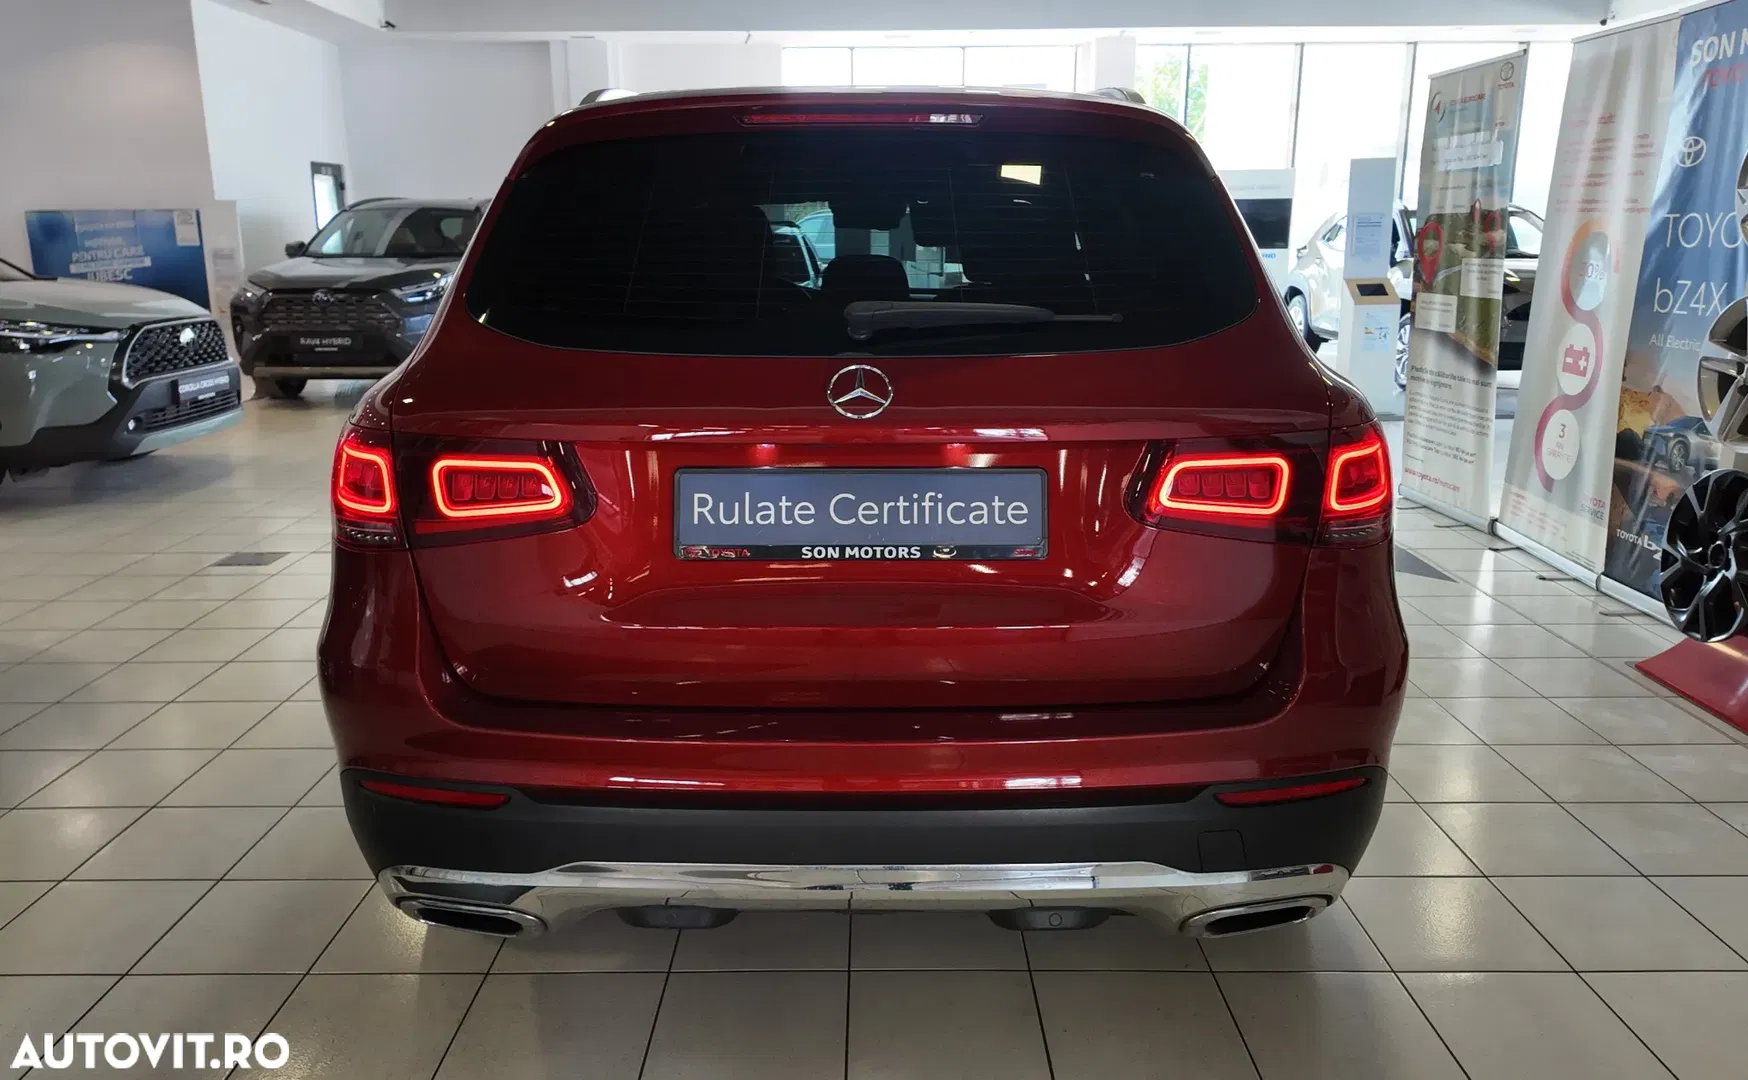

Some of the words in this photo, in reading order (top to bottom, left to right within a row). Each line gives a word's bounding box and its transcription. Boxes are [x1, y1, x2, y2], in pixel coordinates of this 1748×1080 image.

[1690, 31, 1736, 68] SON
[1653, 277, 1728, 316] bZ4X
[1649, 333, 1664, 347] All
[1665, 335, 1702, 352] Electric
[1559, 423, 1567, 439] 3
[692, 492, 816, 525] Rulate
[828, 492, 1029, 525] Certificate
[1616, 528, 1643, 546] TOYOTA
[801, 546, 840, 559] SON
[844, 546, 921, 559] MOTORS
